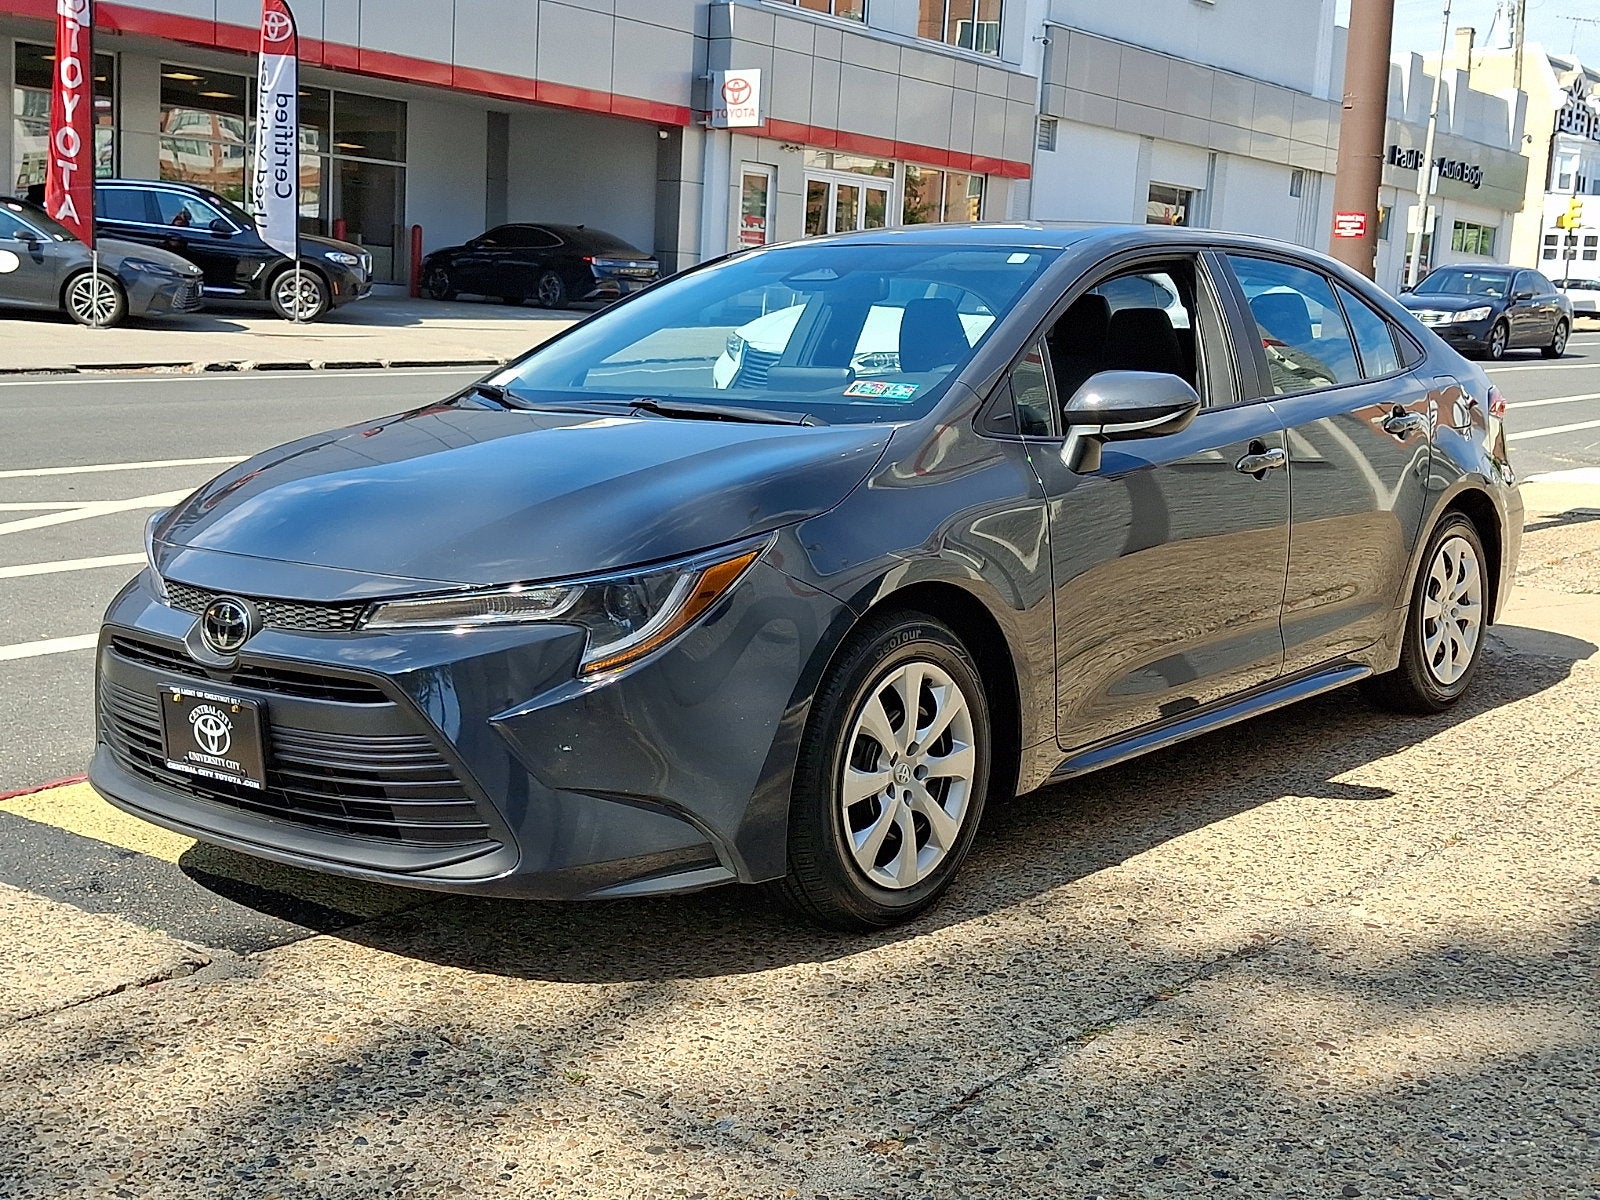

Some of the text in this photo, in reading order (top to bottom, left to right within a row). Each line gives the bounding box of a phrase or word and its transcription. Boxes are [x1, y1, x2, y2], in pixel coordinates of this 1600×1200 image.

[55, 20, 83, 226] TOYOTA
[715, 108, 756, 119] TOYOTA
[1394, 145, 1417, 168] Paul
[1440, 158, 1462, 180] Auto
[188, 704, 234, 731] CENTRAL CITY
[166, 761, 198, 775] CENTRAL
[197, 768, 213, 778] CITY
[214, 771, 241, 785] TOYOTA
[188, 751, 241, 771] UNIVERSITY CITY
